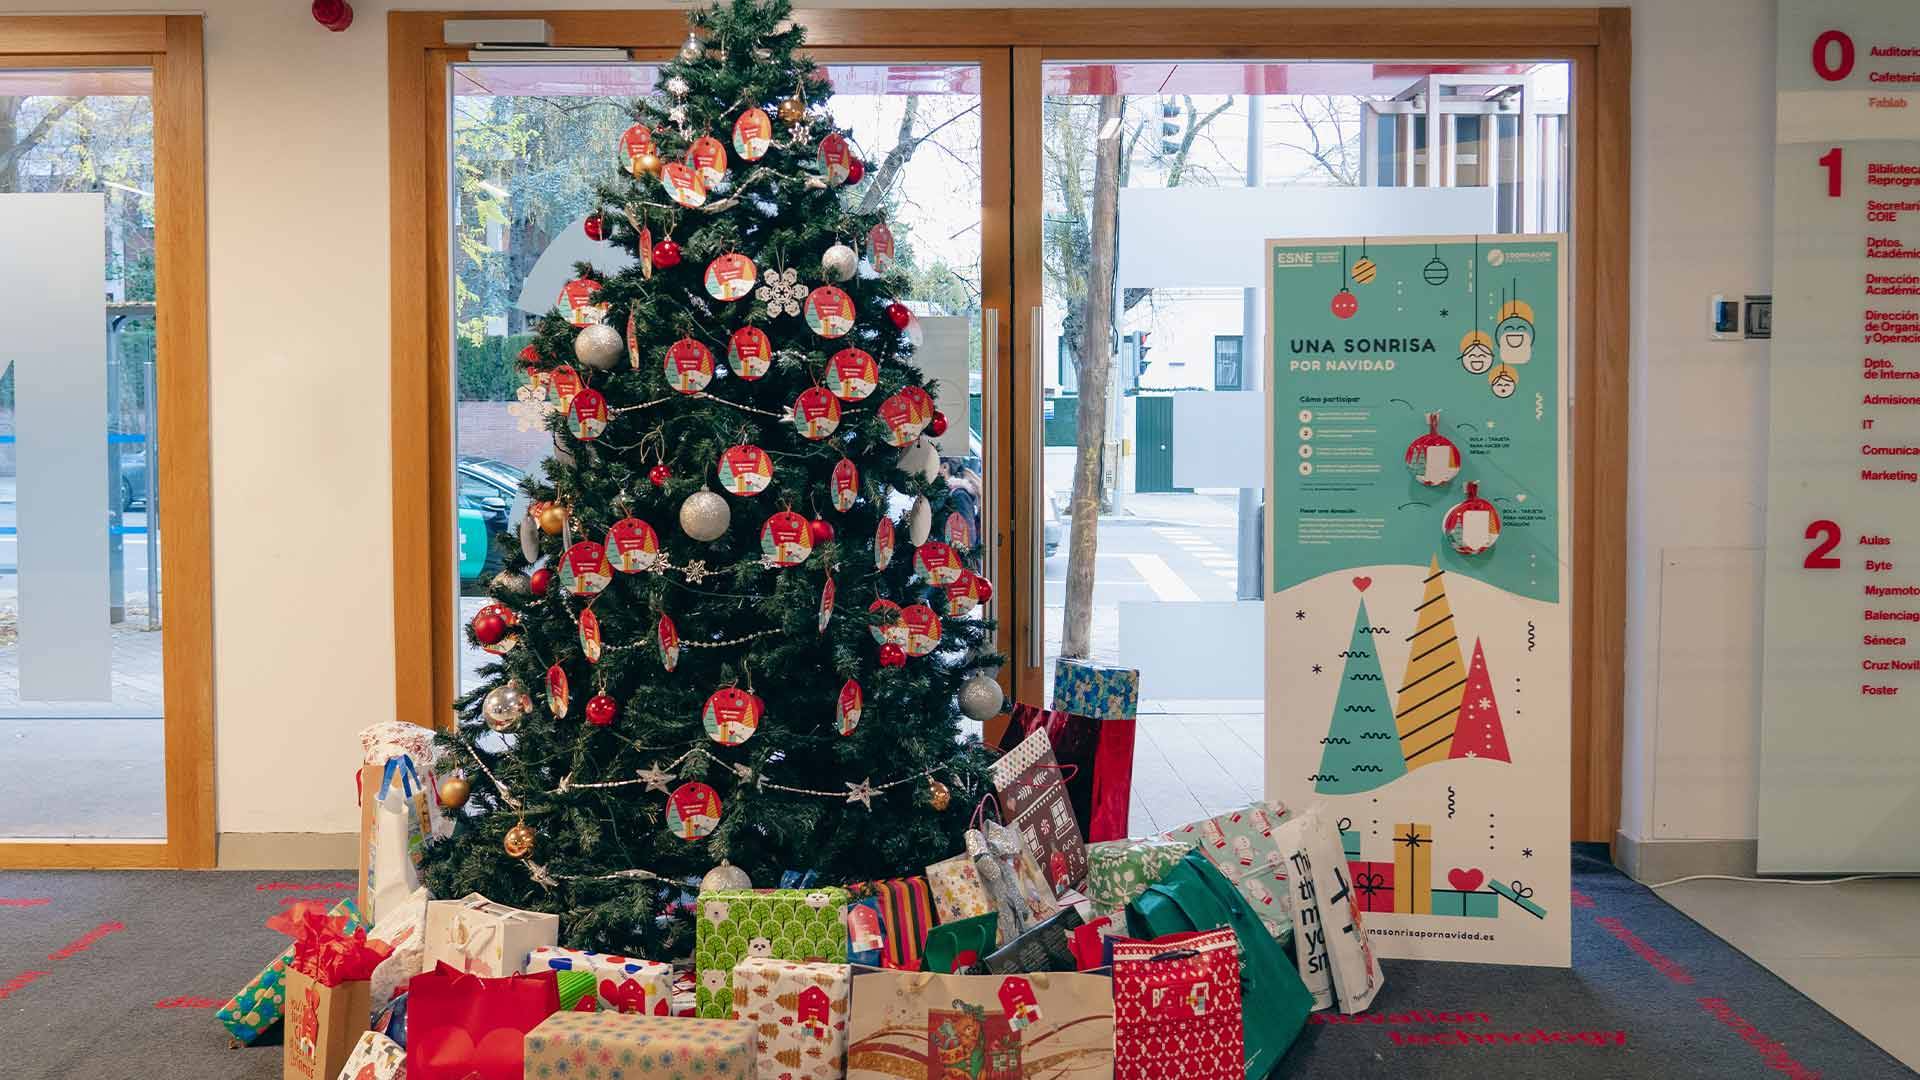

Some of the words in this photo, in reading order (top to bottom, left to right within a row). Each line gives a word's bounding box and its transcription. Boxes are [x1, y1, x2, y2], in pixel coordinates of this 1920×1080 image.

[1812, 30, 1855, 81] 0
[1869, 97, 1908, 108] Fablab
[1818, 148, 1842, 197] 1
[1868, 163, 1920, 174] Bibliotec
[1867, 211, 1897, 221] COIE
[1867, 237, 1904, 248] Dptos.
[1278, 252, 1313, 265] ESNE
[1866, 273, 1920, 284] Dirección
[1865, 310, 1919, 321] Dirección
[1864, 321, 1879, 332] de
[1880, 321, 1920, 333] Organi
[1864, 335, 1871, 345] y
[1290, 338, 1335, 354] UNA
[1344, 338, 1436, 353] SONRISA
[1290, 360, 1321, 371] POR
[1326, 359, 1396, 371] NAVIDAD
[1864, 358, 1894, 369] Dpto.
[1863, 369, 1879, 379] de
[1881, 370, 1920, 379] Interna
[1862, 419, 1874, 429] IT
[1862, 445, 1920, 455] Comunica
[1861, 469, 1917, 482] Marketing
[1804, 520, 1841, 568] 2
[1859, 536, 1890, 545] Aulas
[1865, 560, 1893, 572] Byte
[1863, 634, 1906, 645] Séneca
[1862, 660, 1890, 671] Cruz
[1862, 685, 1899, 695] Foster
[1290, 848, 1312, 876] Thi
